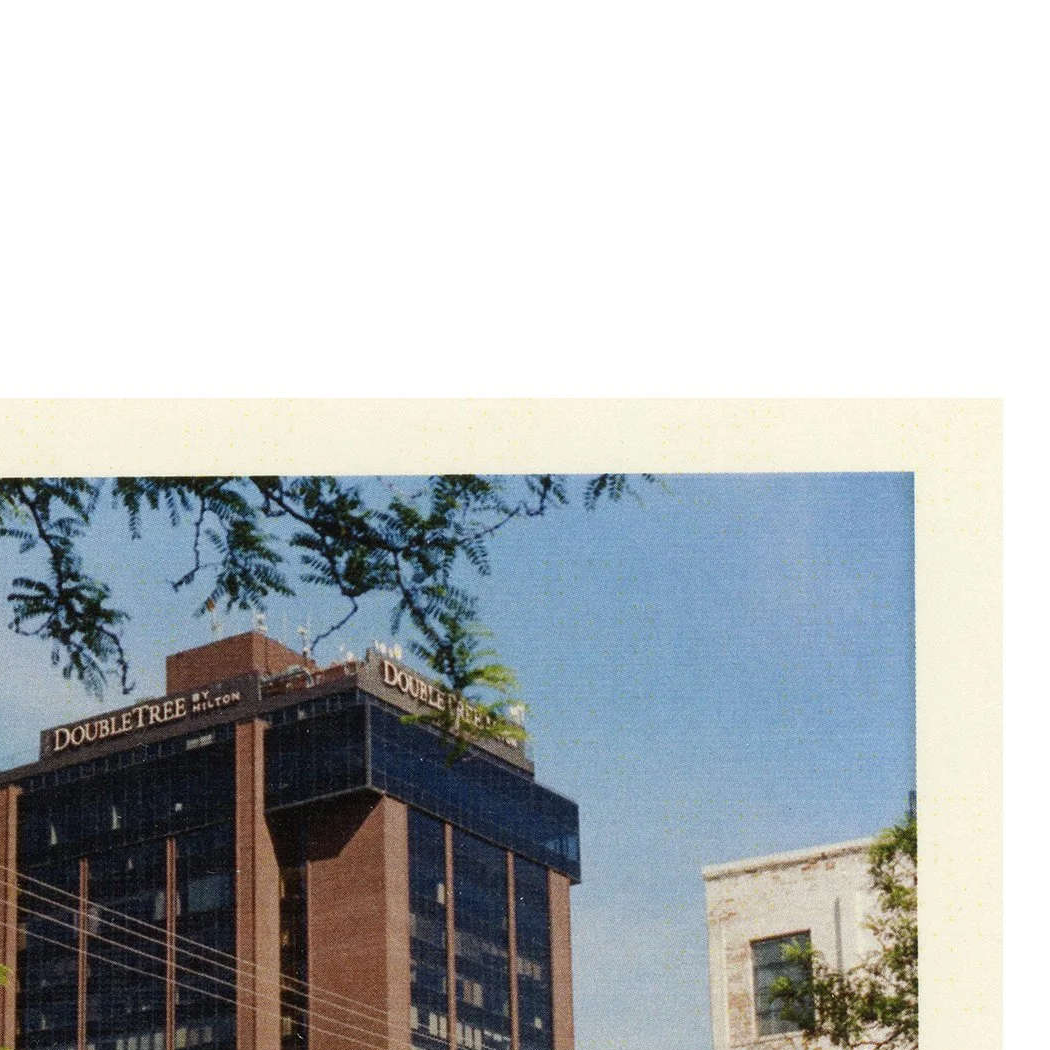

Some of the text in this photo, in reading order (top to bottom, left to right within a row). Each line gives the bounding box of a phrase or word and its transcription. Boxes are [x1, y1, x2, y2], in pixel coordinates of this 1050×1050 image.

[192, 691, 210, 702] BY
[192, 692, 241, 712] HILTON
[53, 698, 187, 751] DOUBLETREE
